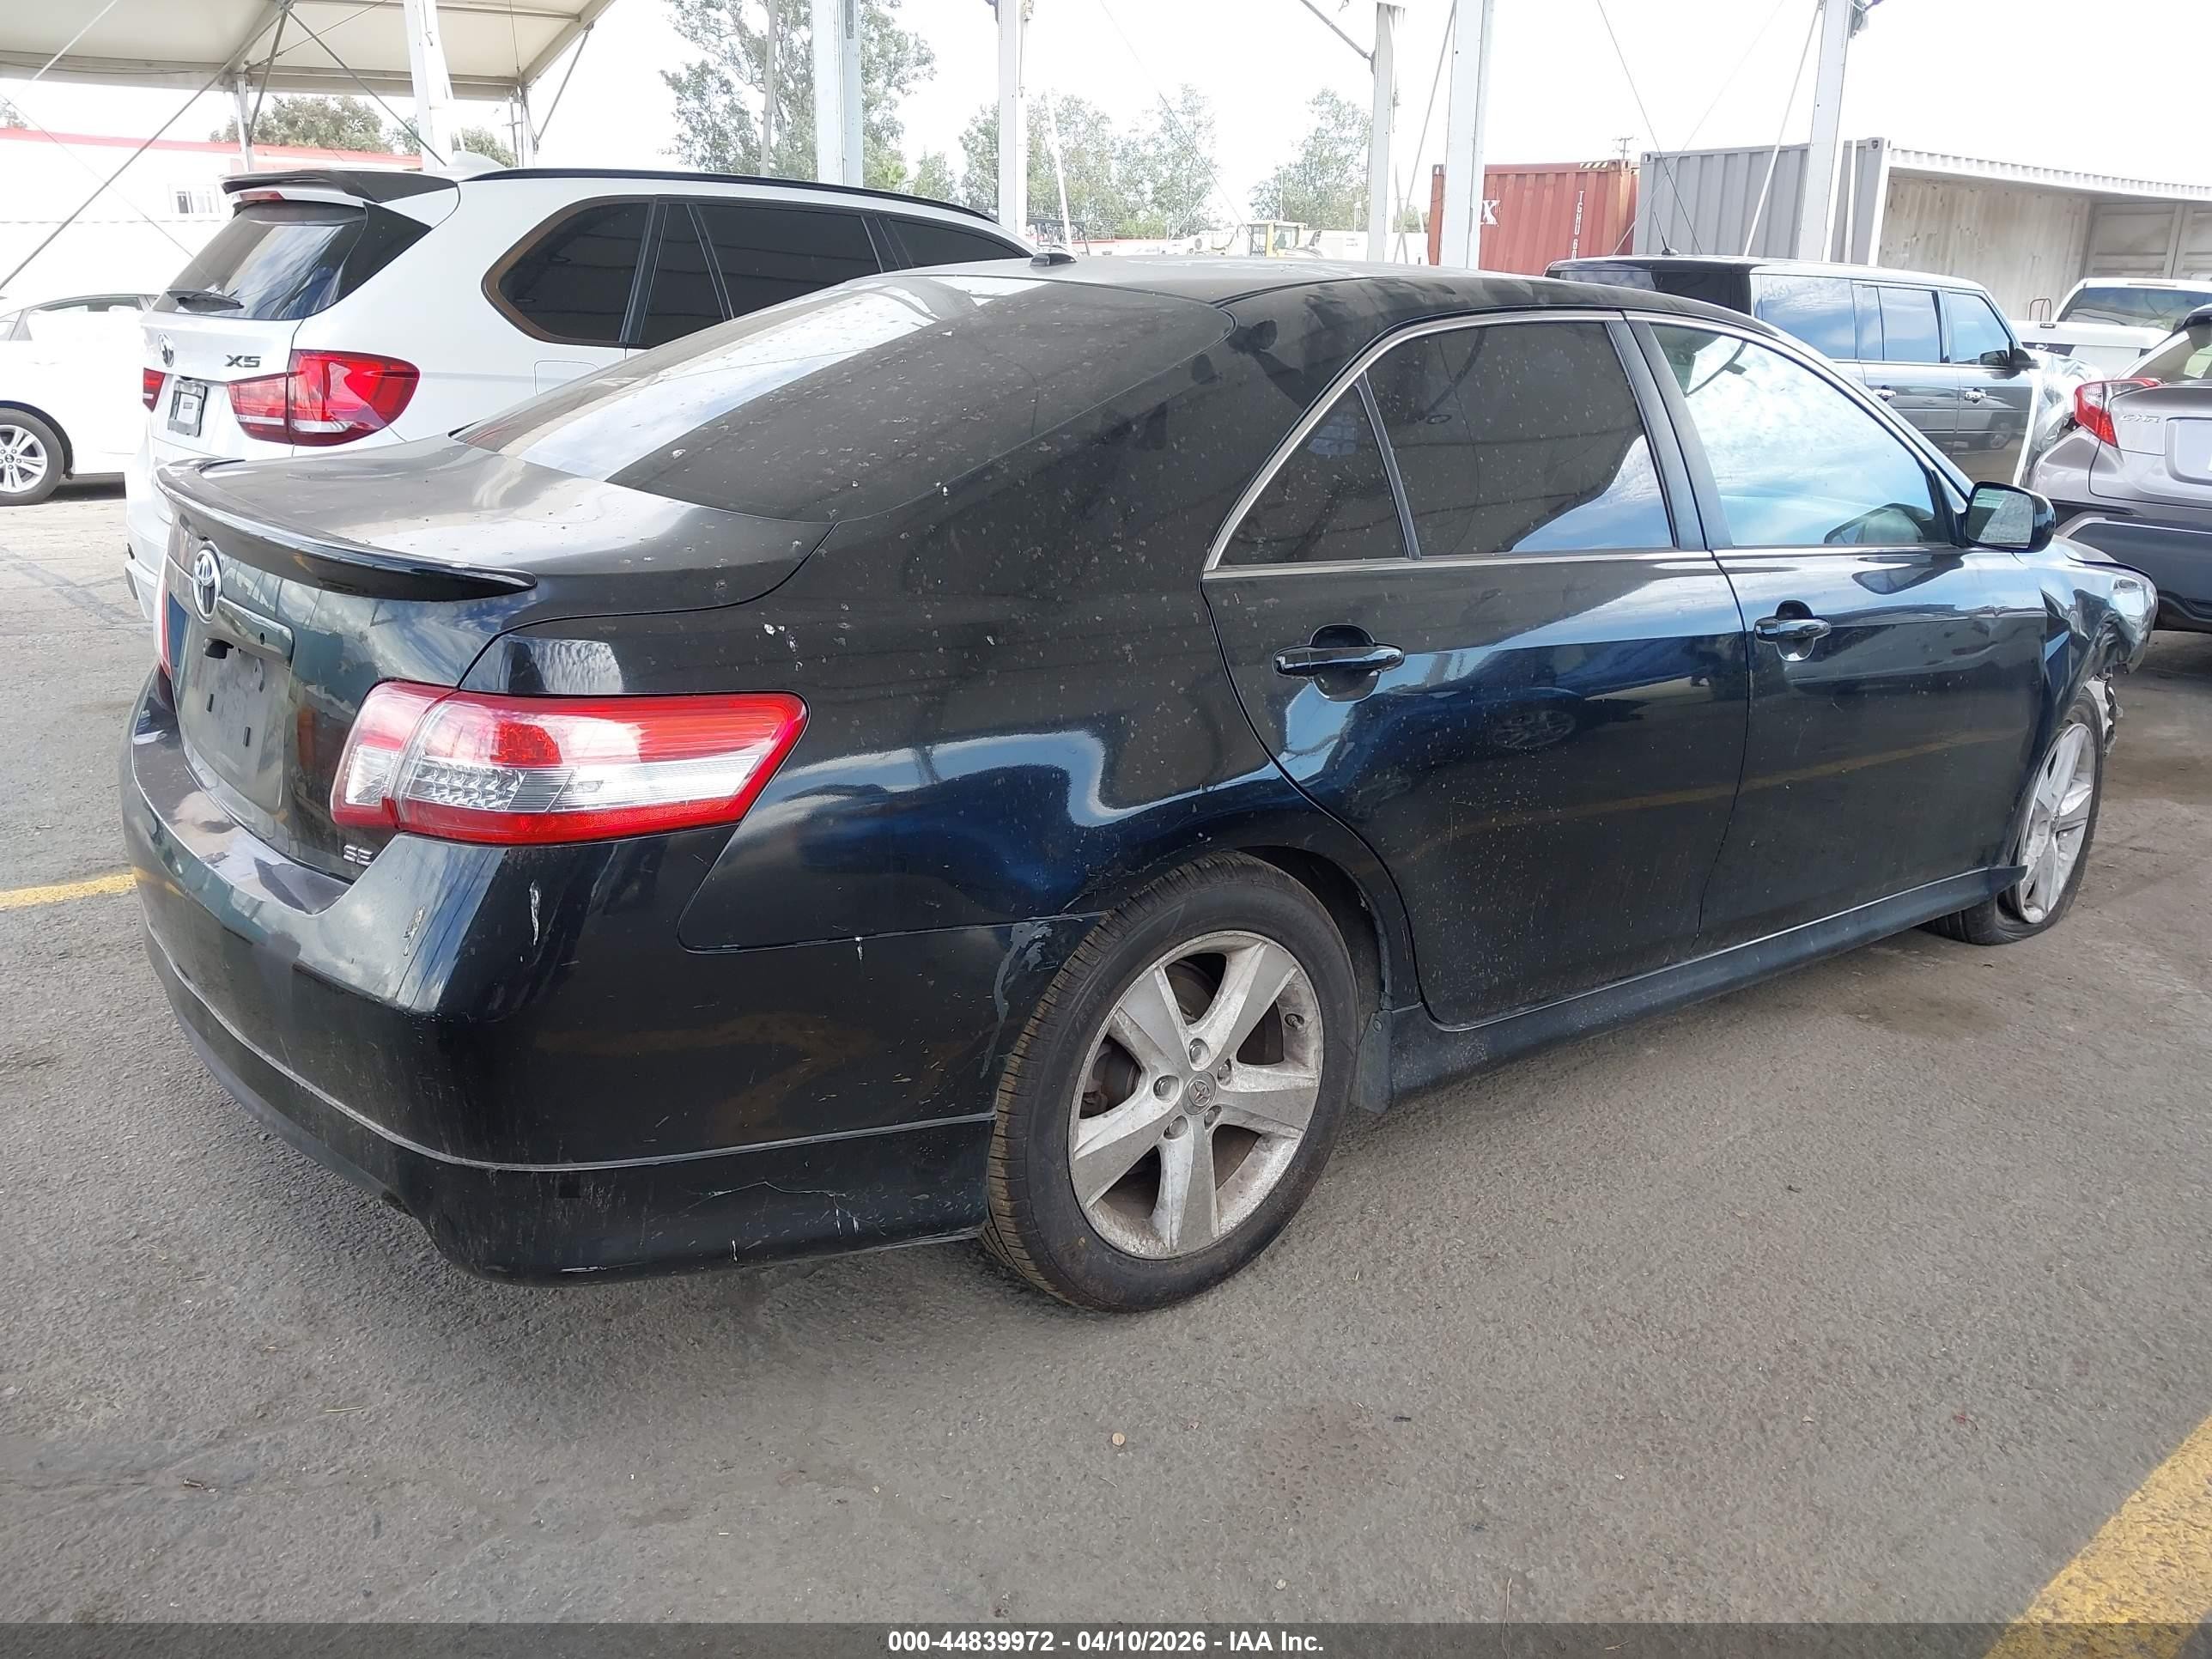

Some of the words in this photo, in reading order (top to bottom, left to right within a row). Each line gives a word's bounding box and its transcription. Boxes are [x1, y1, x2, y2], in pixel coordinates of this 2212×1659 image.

[1574, 190, 1585, 235] TGHU
[224, 354, 261, 368] X5
[343, 844, 373, 866] SE
